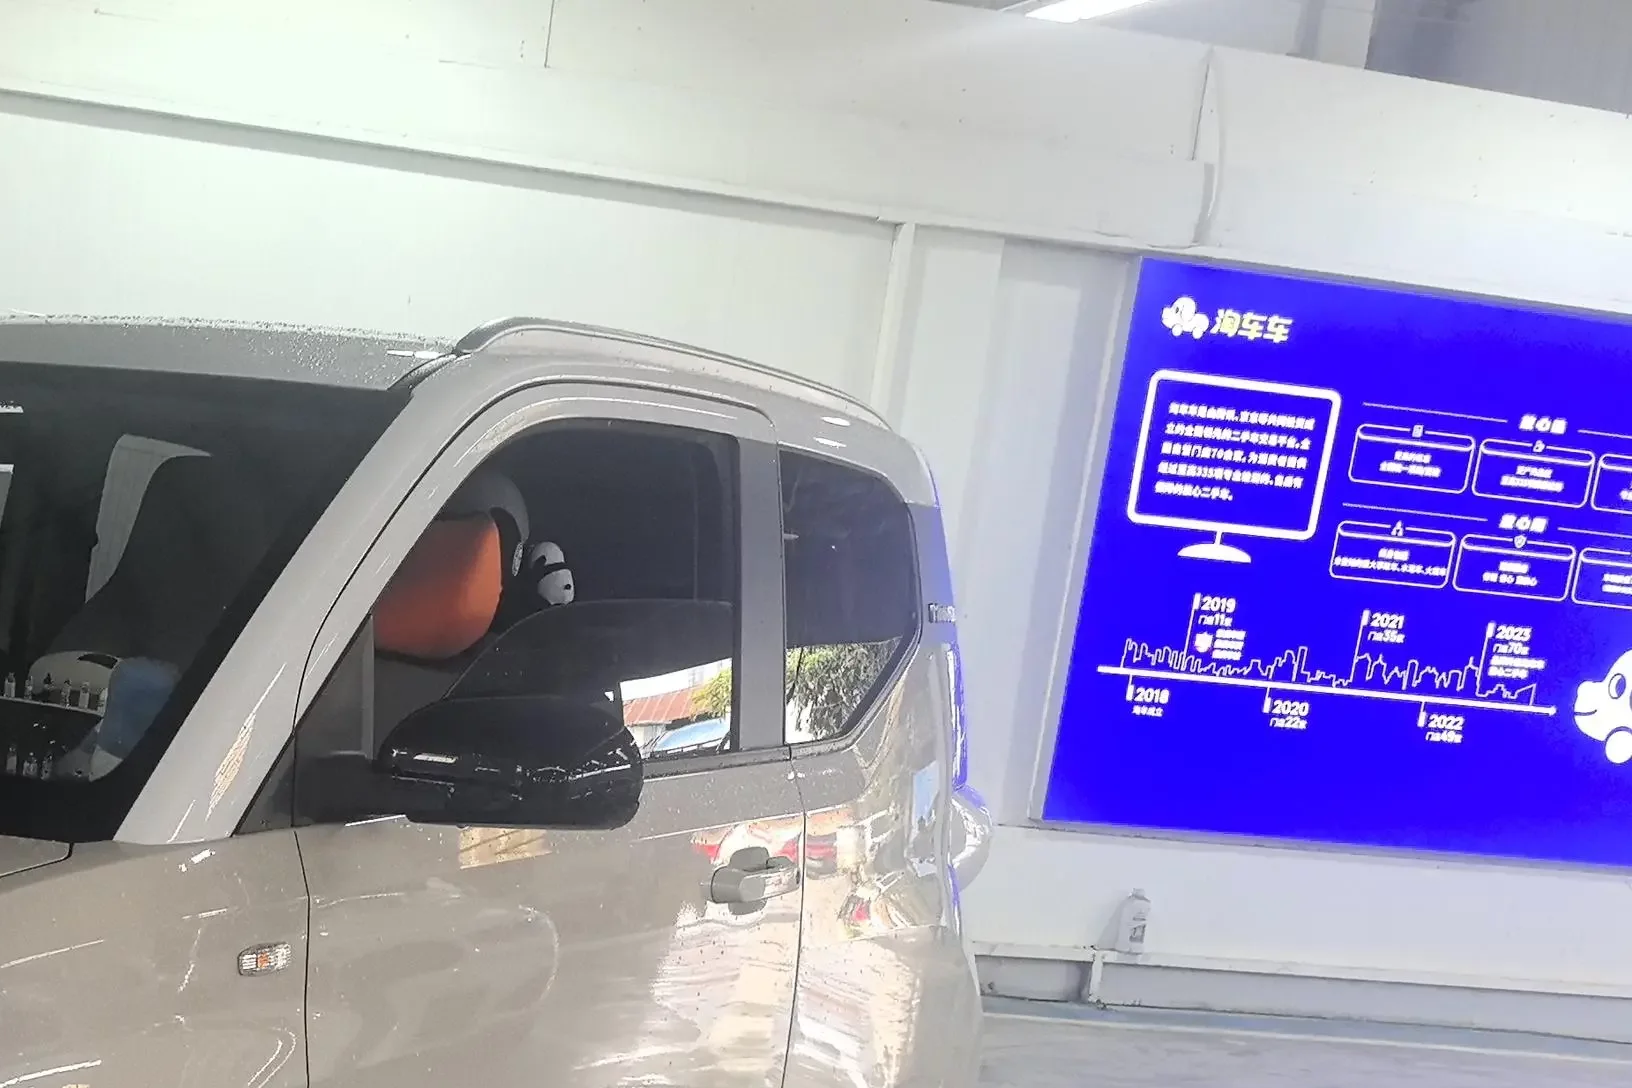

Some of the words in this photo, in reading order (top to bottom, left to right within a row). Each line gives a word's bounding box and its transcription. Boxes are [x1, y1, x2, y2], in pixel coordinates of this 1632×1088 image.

[1210, 308, 1293, 343] 淘车车
[1200, 596, 1236, 613] 2019
[1370, 613, 1405, 629] 2021
[1495, 625, 1532, 642] 2023
[1133, 687, 1170, 704] 2018
[1272, 700, 1310, 716] 2020
[1427, 714, 1465, 730] 2022
